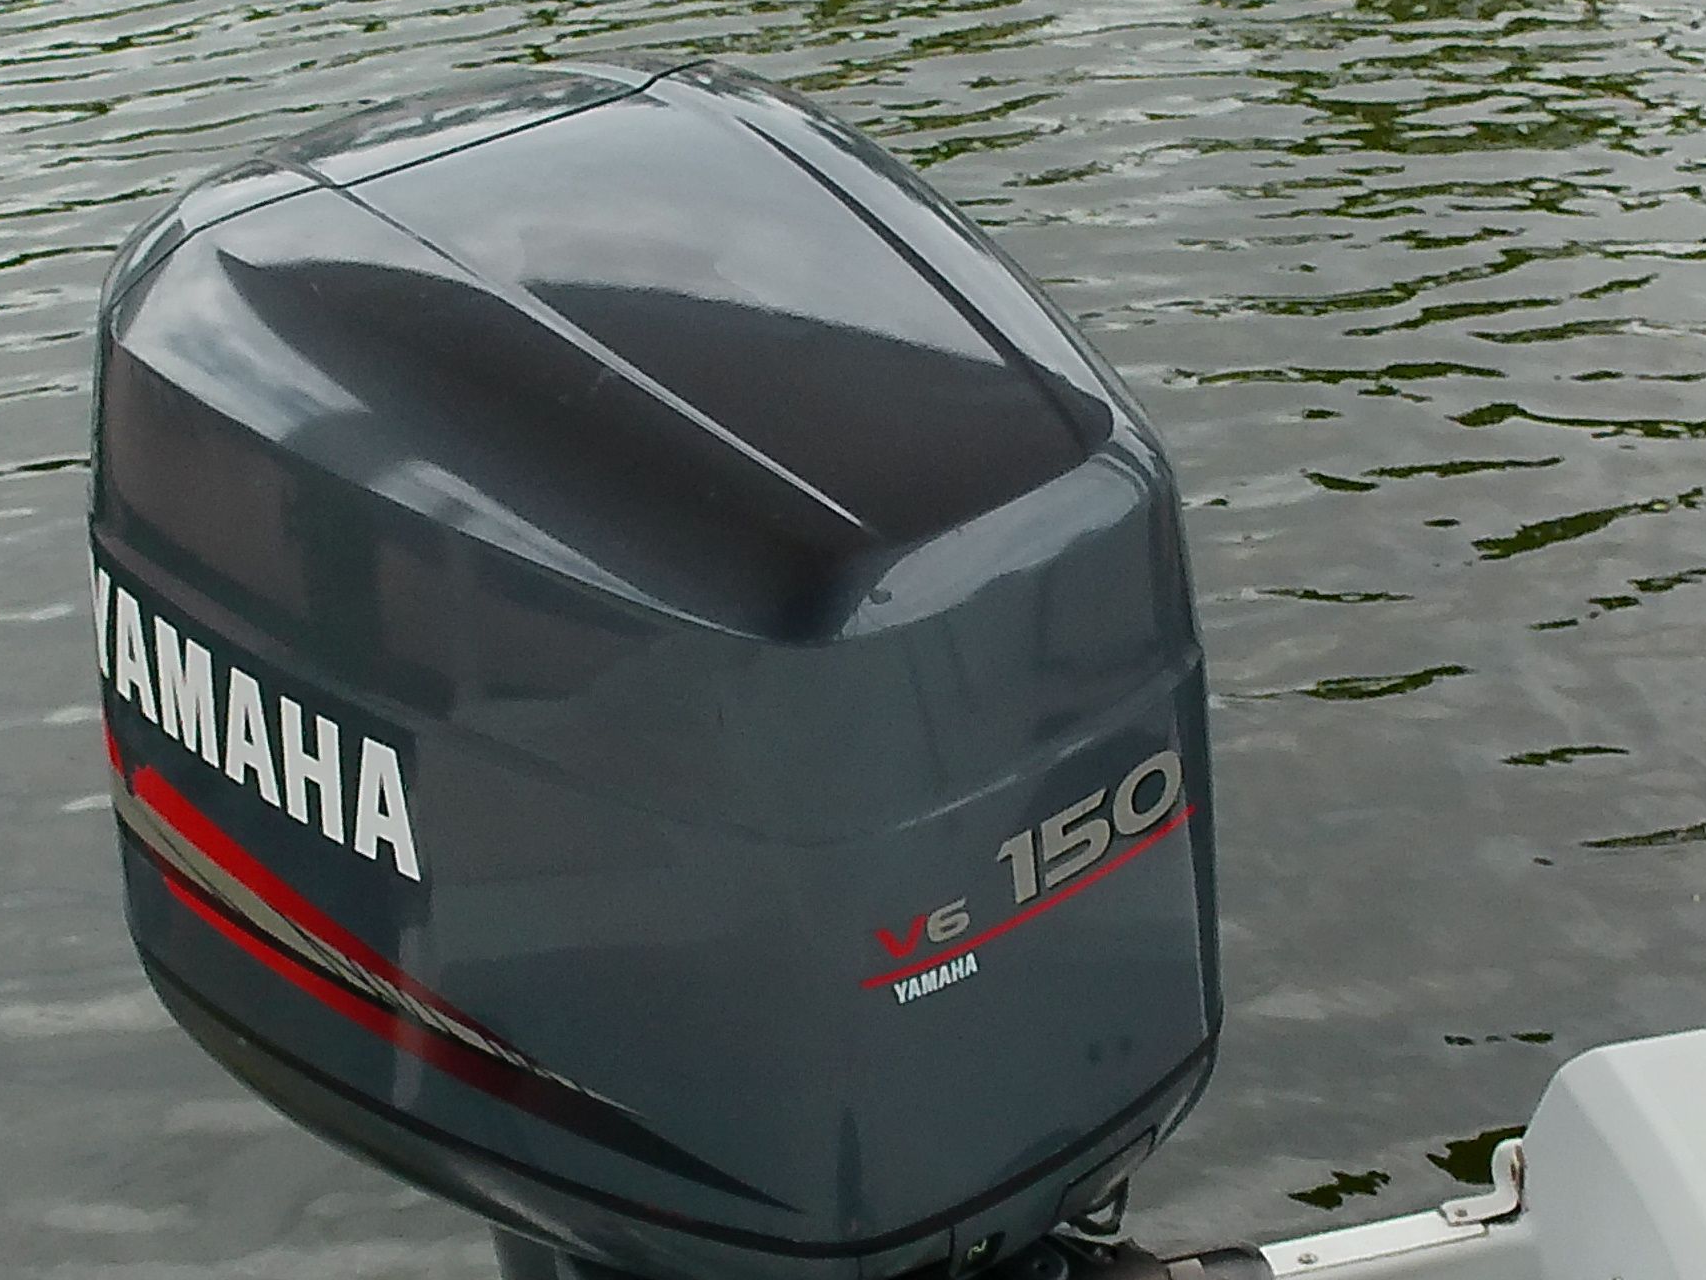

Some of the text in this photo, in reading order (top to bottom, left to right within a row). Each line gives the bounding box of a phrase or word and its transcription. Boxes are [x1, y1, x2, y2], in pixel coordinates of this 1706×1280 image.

[89, 548, 422, 883] YAMAHA
[874, 750, 1183, 960] V6 150
[893, 951, 980, 1006] YAMAHA
